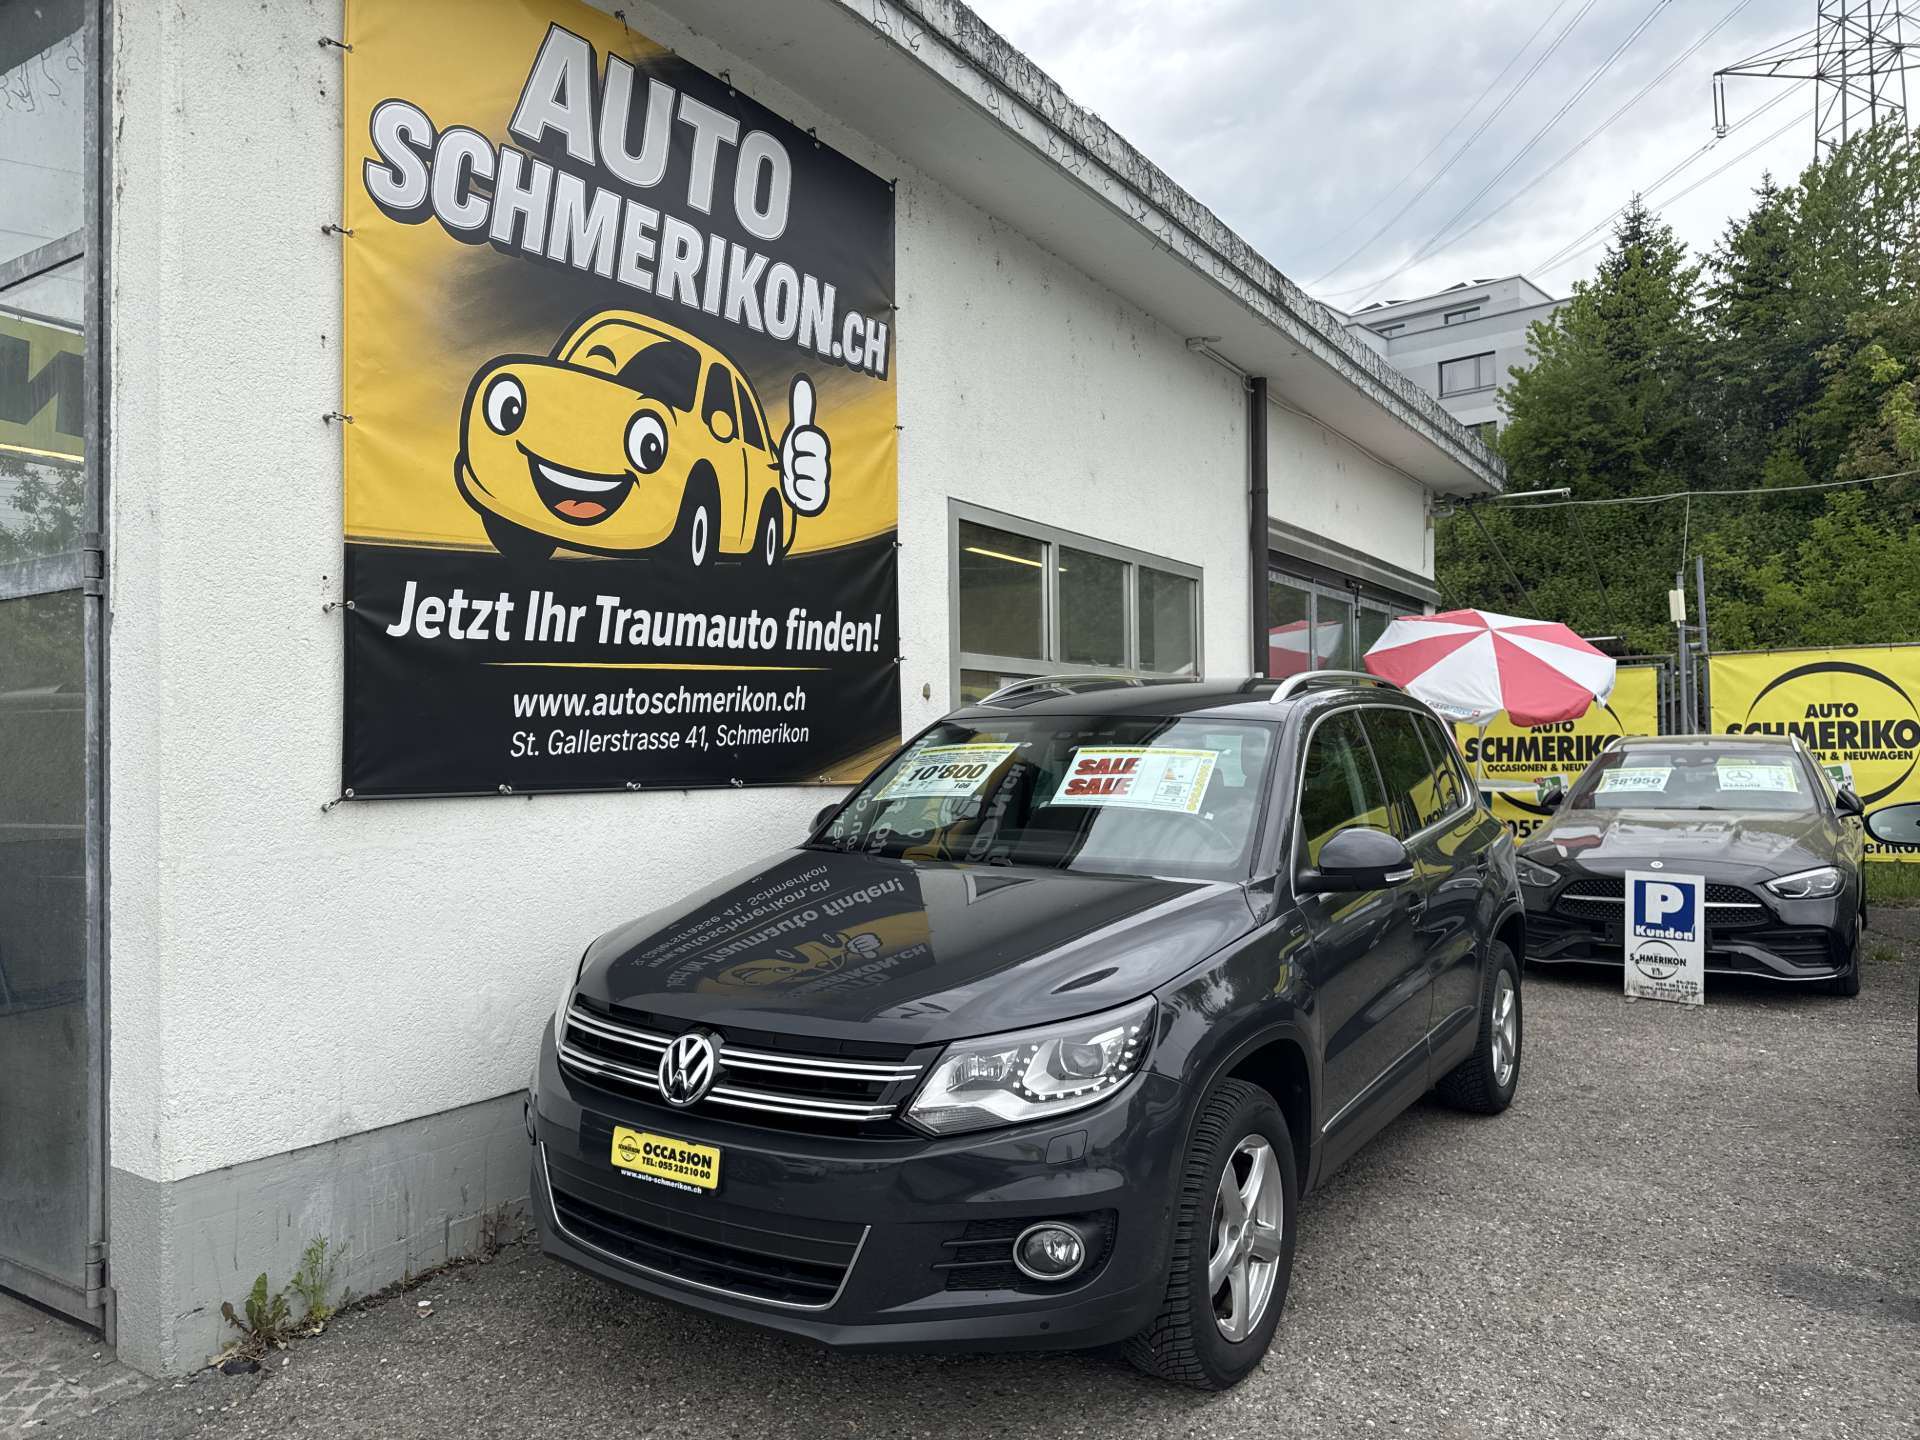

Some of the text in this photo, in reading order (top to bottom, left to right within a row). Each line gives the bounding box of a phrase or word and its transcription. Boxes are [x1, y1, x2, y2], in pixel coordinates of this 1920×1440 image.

[511, 23, 793, 241] AUTO
[365, 101, 888, 374] SCHMERIKON.CH
[387, 581, 881, 653] Jetzt Ihr Traumauto finden!
[513, 686, 806, 718] www.autoschmerikon.ch
[1805, 702, 1858, 718] AUTO
[1530, 720, 1575, 734] AUTO
[510, 723, 810, 757] St. Gallerstrasse 41, Schmerikon
[1074, 757, 1143, 776] SALE
[1830, 751, 1841, 761] &
[1844, 750, 1914, 761] NEUWAGEN
[908, 763, 989, 783] 10'800
[1487, 763, 1548, 773] OCCASIONEN
[1550, 762, 1559, 773] &
[1064, 777, 1134, 797] SALE
[1645, 882, 1685, 925] P
[1635, 924, 1695, 942] Kunden
[642, 1142, 712, 1169] OCCASION
[642, 1156, 711, 1179] TEL: 055 282 10 00
[621, 1169, 702, 1194] www.auto-schmerikon.ch
